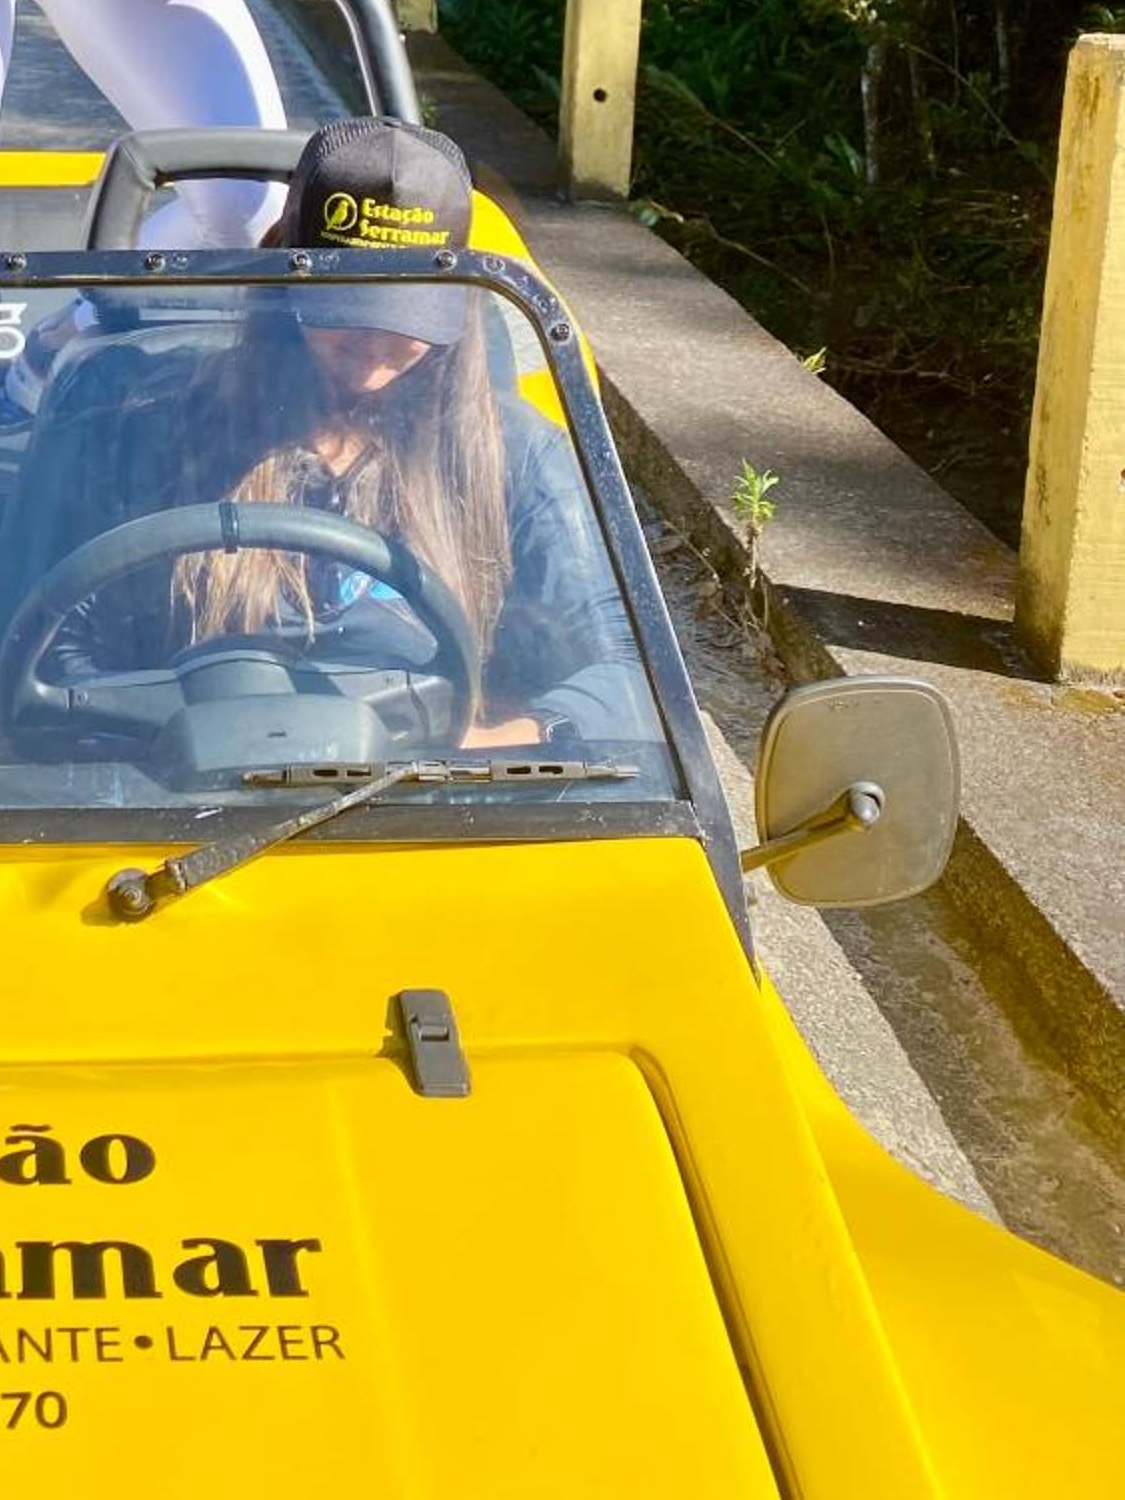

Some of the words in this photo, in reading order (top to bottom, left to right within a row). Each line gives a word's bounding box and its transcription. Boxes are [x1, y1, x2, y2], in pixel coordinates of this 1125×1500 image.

[361, 198, 434, 224] Estação
[360, 218, 450, 245] Serramar
[165, 1324, 346, 1362] LAZER
